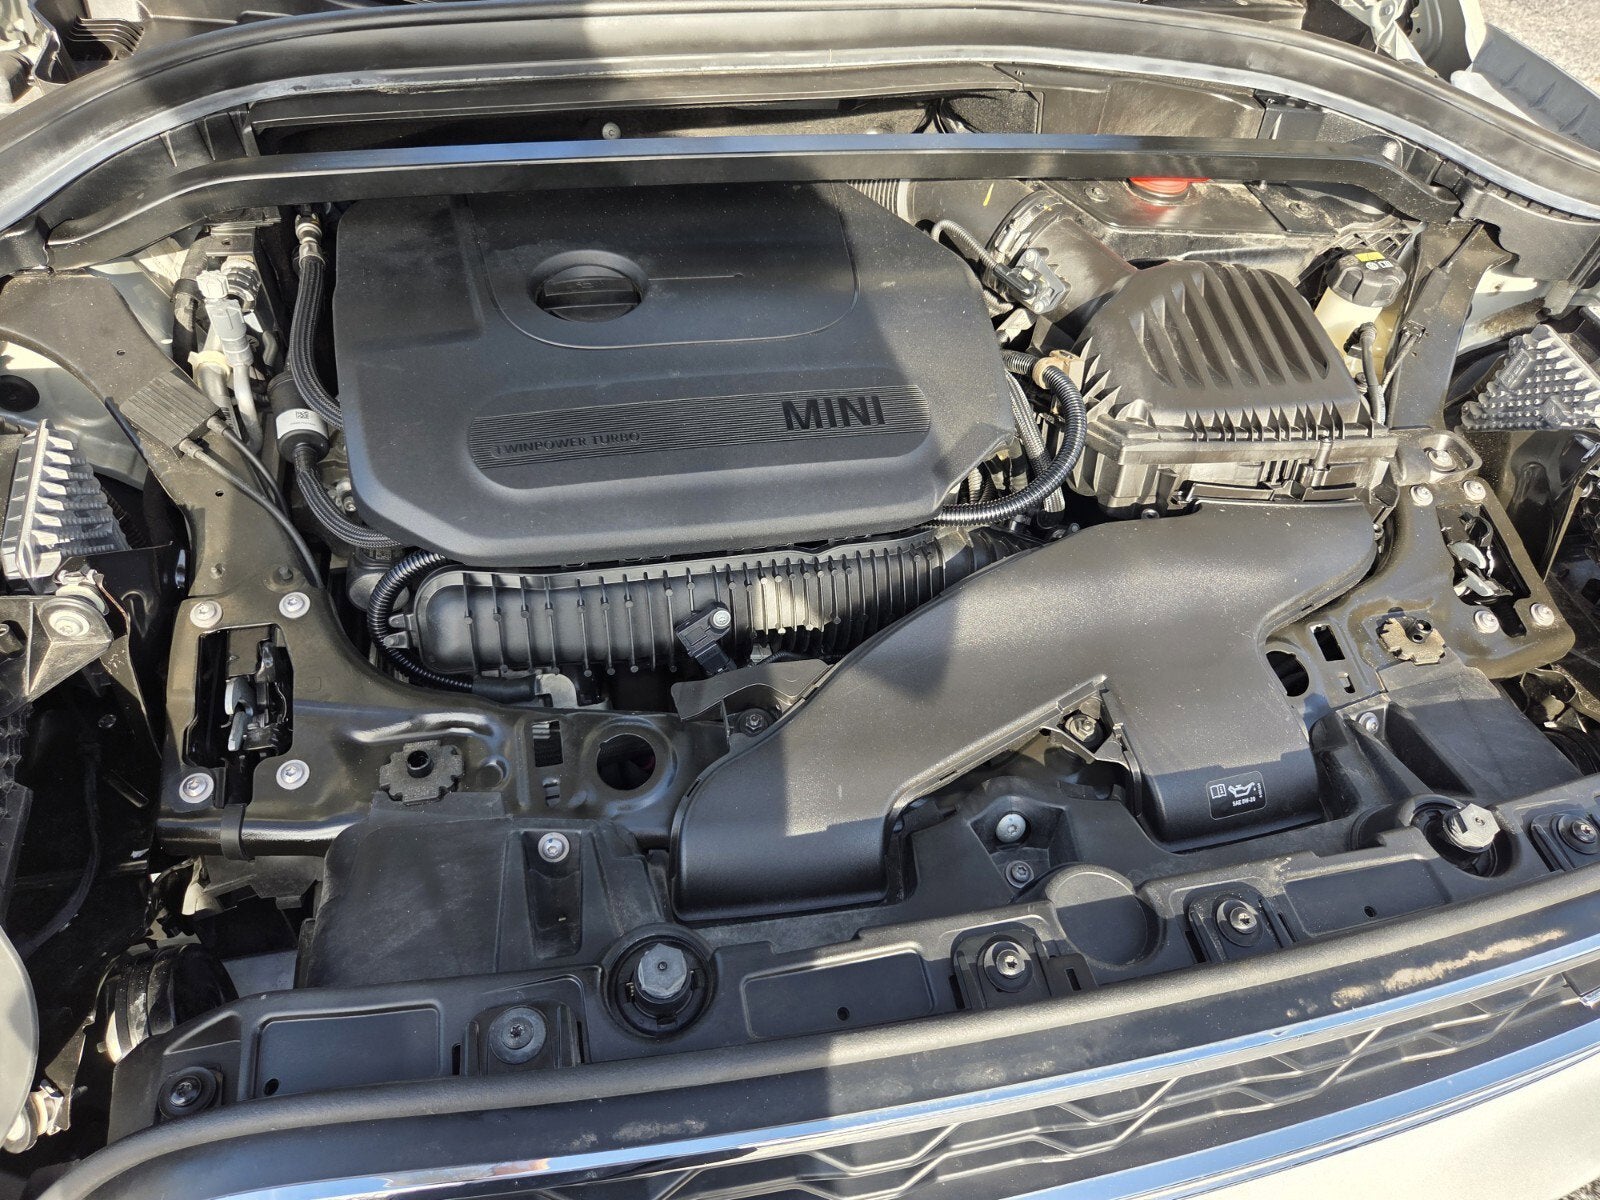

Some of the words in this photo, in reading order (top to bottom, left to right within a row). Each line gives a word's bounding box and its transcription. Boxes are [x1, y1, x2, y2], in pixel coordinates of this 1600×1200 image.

[783, 396, 885, 431] MINI
[495, 437, 587, 455] TWINPOWER
[593, 432, 640, 445] TURBO
